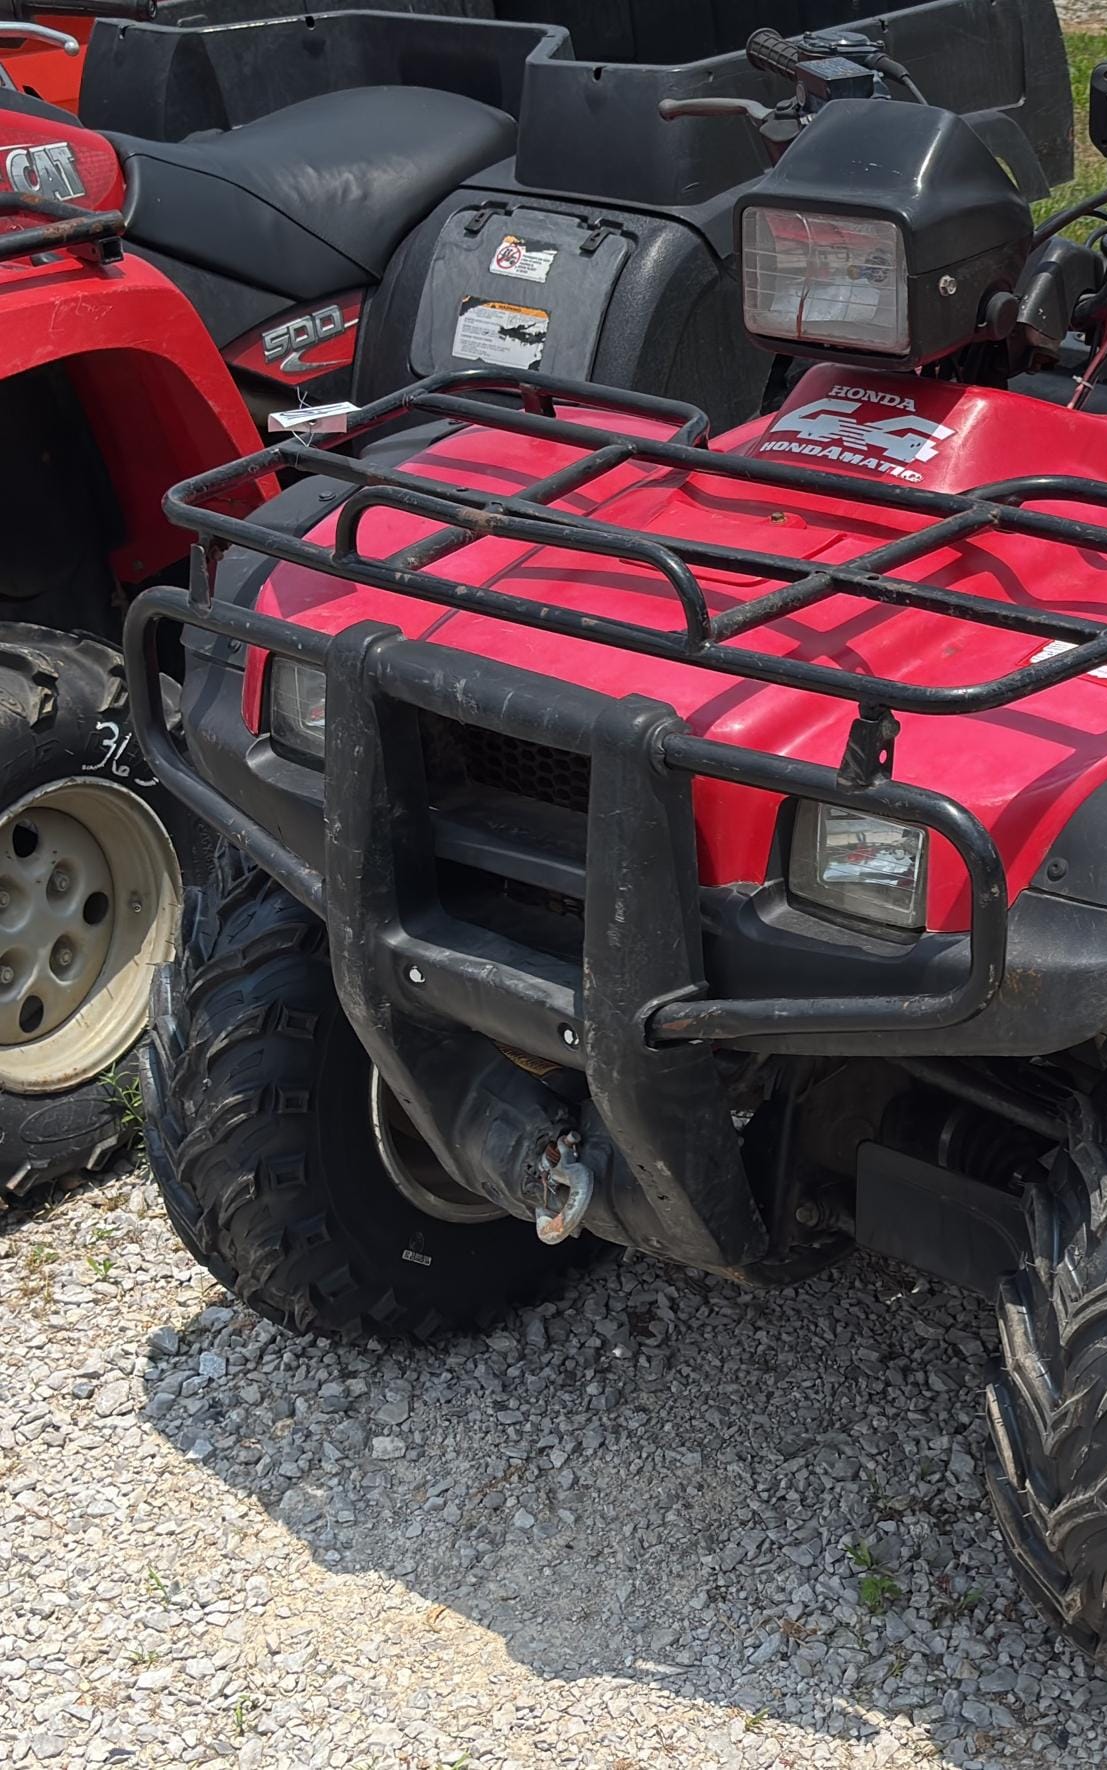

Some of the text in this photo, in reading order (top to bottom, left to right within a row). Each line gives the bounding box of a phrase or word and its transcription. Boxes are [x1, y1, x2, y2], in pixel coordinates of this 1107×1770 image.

[6, 142, 85, 201] CAT
[262, 305, 345, 363] 500
[828, 385, 917, 412] HONDA
[759, 441, 923, 483] HONDAMATIC
